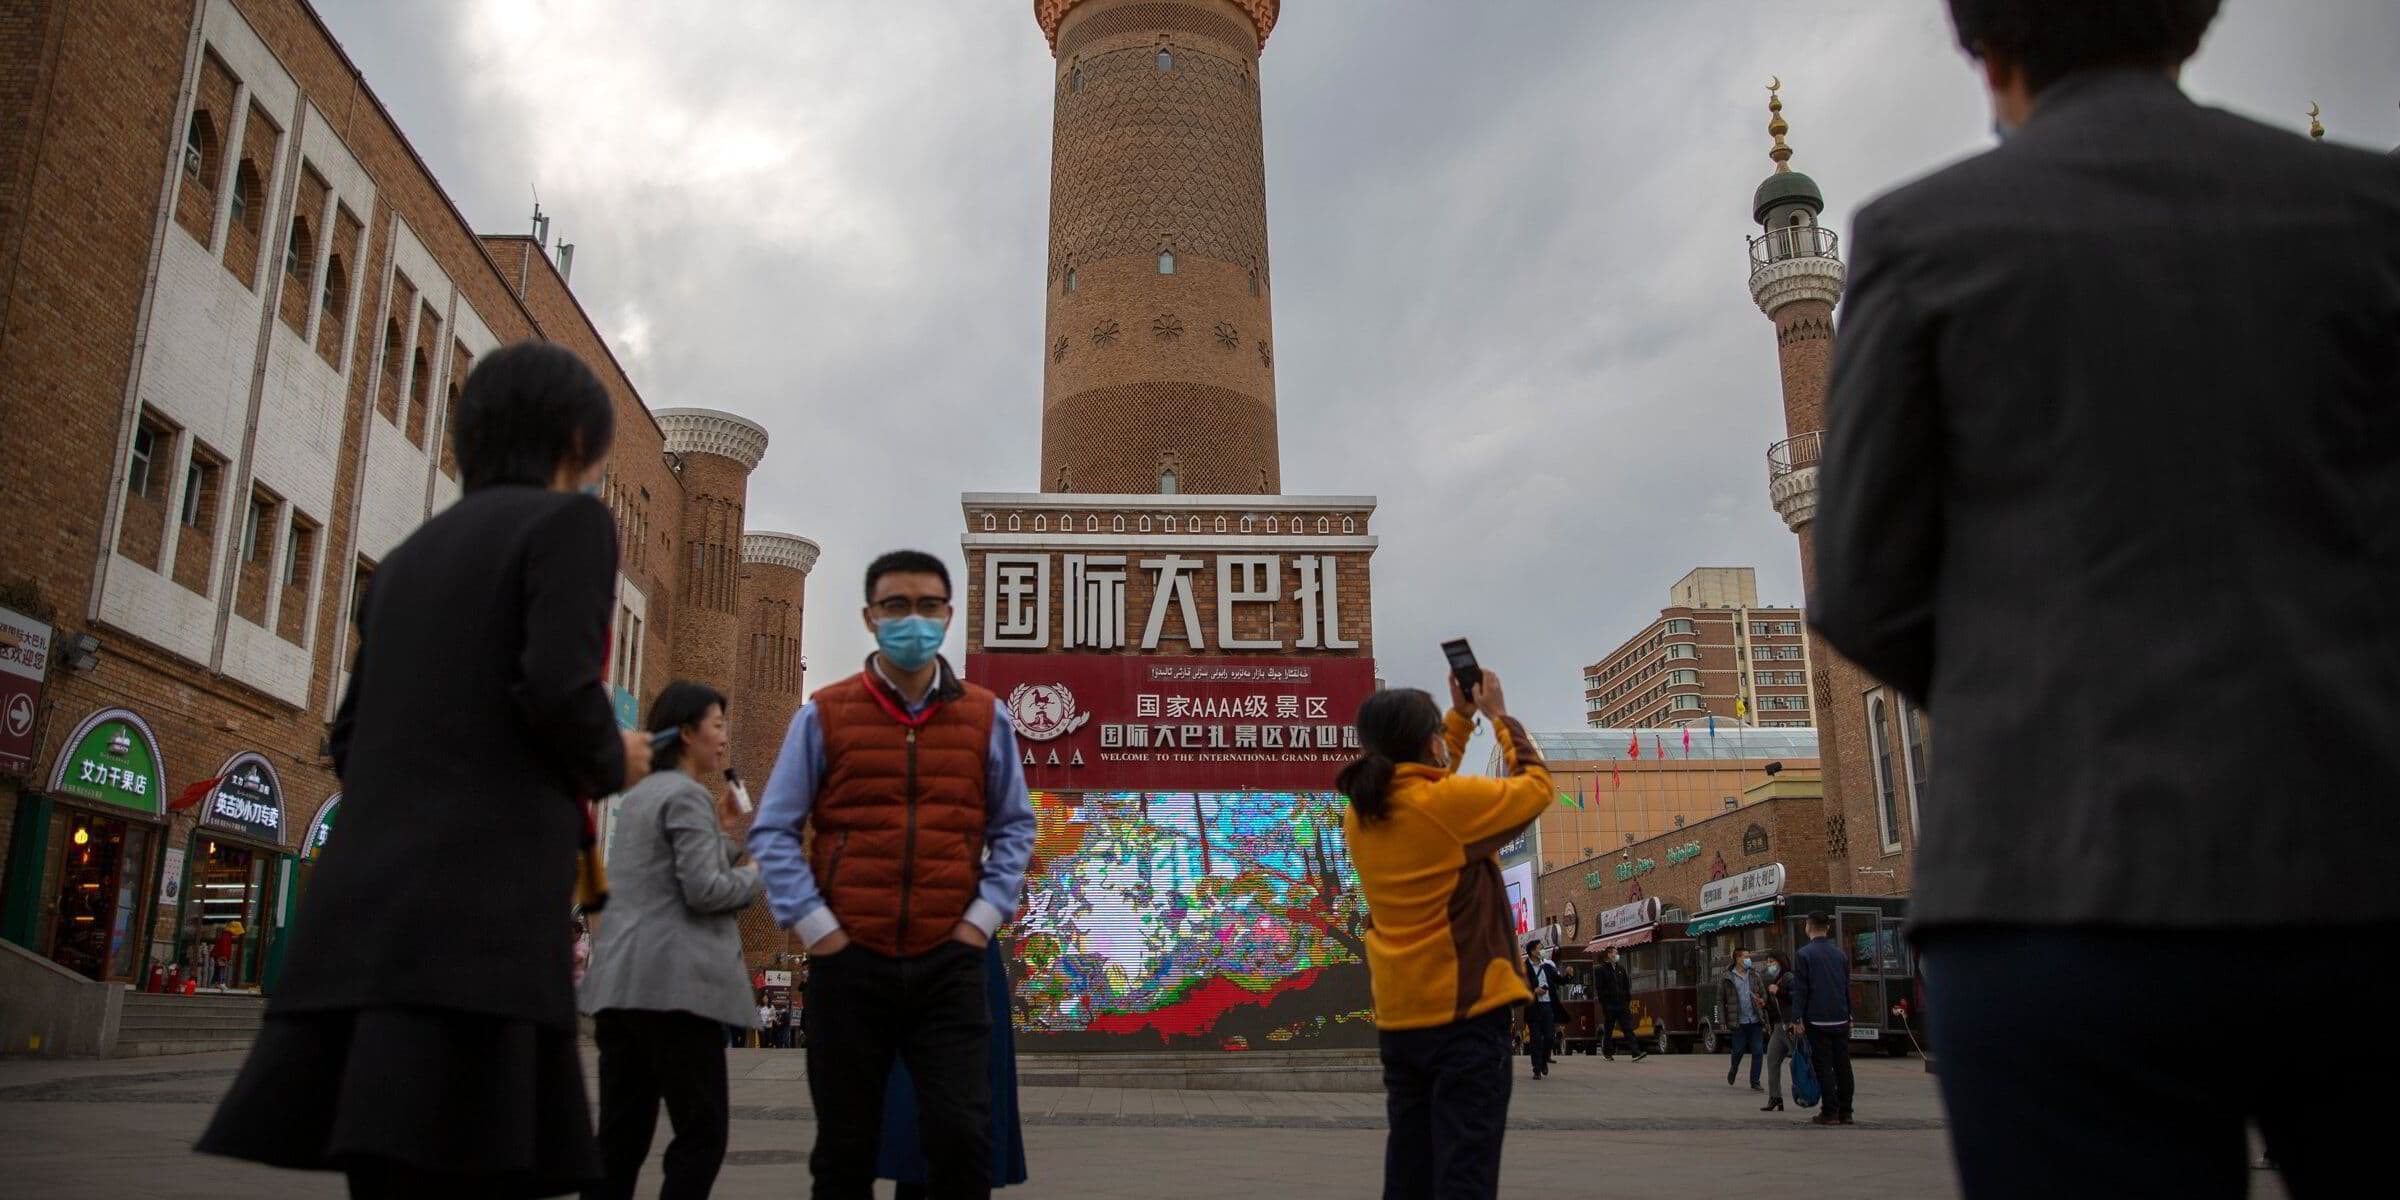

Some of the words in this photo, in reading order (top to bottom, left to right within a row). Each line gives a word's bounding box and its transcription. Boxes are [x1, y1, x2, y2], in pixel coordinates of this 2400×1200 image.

[984, 553, 1359, 649] 国际大巴扎
[1100, 725, 1362, 749] 国际大巴扎景区欢迎您
[1100, 753, 1150, 762] WELCOME
[1155, 753, 1170, 762] TO
[1174, 753, 1194, 762] THE
[1199, 753, 1279, 762] INTERNATIONAL
[1281, 753, 1318, 762] GRAND
[80, 758, 147, 796] 艾力干果店
[215, 791, 279, 829] 英吉沙小刀专卖
